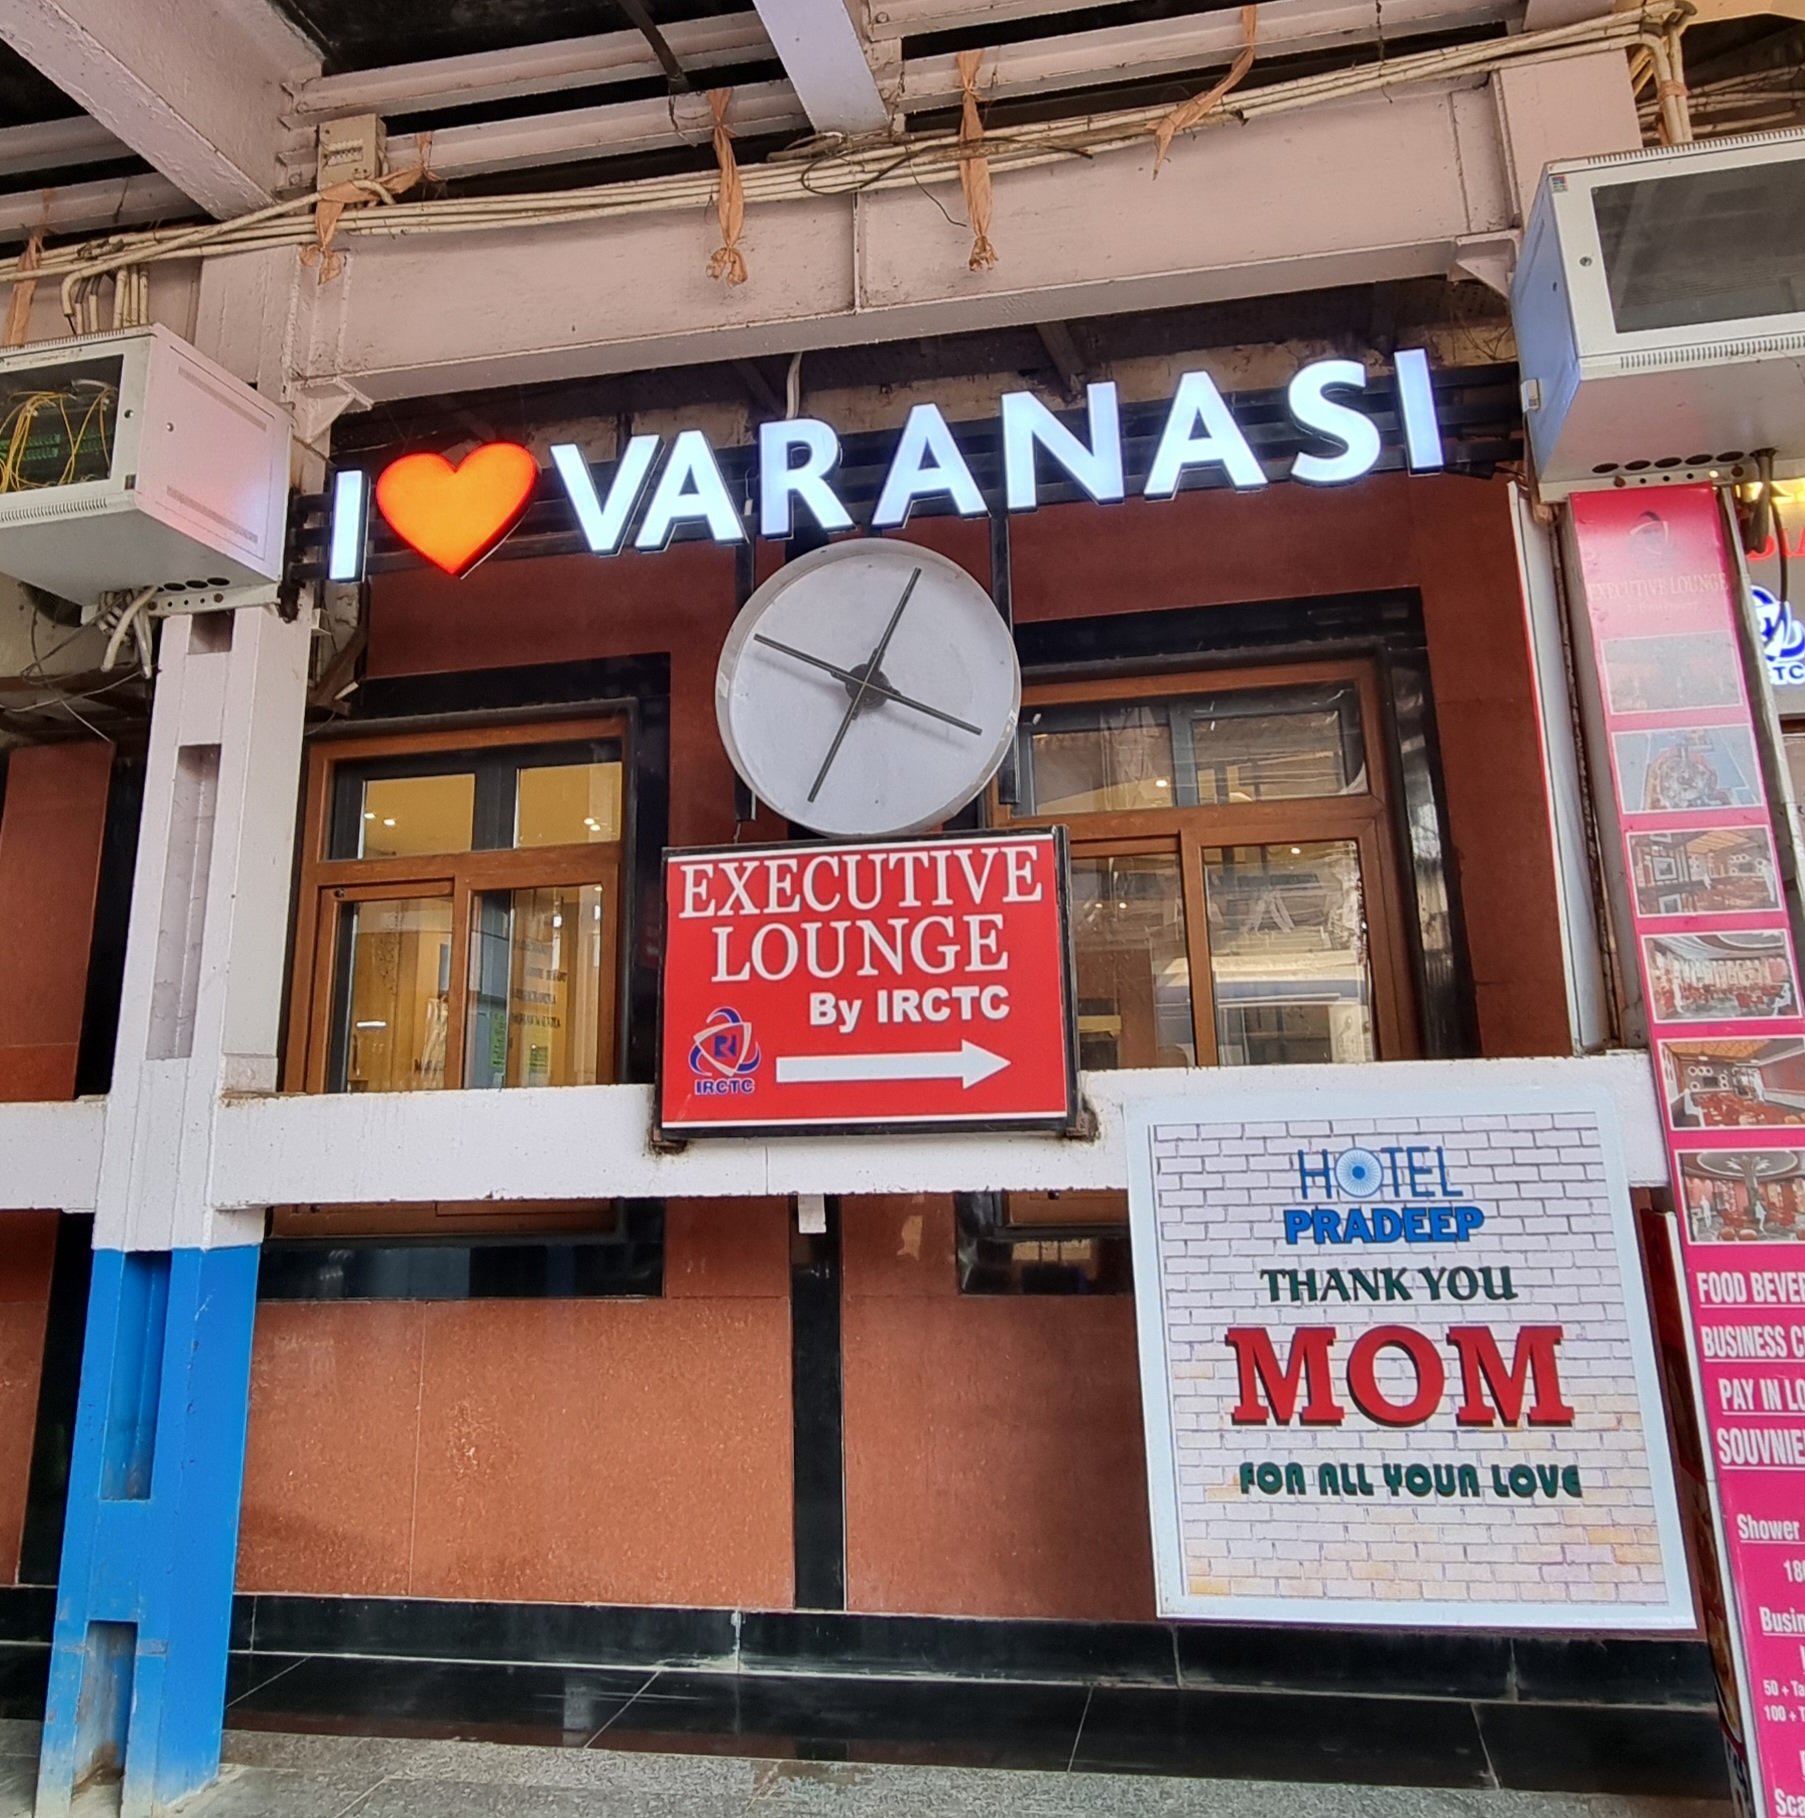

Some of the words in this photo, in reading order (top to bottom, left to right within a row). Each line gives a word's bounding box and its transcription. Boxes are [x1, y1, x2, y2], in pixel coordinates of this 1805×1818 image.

[328, 469, 364, 581] I
[550, 347, 1445, 555] VARANASI
[679, 845, 1042, 919] EXECUTIVE
[711, 914, 1009, 983] LOUNGE
[809, 992, 862, 1033] By
[877, 985, 1010, 1024] IRCTC
[694, 1079, 756, 1096] IRCTC
[1297, 1146, 1462, 1200] HOTEL
[1283, 1206, 1485, 1245] PRADEEP
[1260, 1268, 1411, 1303] THANK
[1420, 1265, 1519, 1302] YOU
[1696, 1272, 1747, 1303] FOOD
[1701, 1326, 1787, 1358] BUSINESS
[1224, 1324, 1575, 1427] MOM
[1719, 1379, 1755, 1410] PAY
[1760, 1379, 1782, 1410] IN
[1717, 1428, 1805, 1465] SOUVNIE
[1239, 1461, 1307, 1495] FOR
[1319, 1462, 1374, 1496] ALL
[1384, 1462, 1482, 1498] YOUR
[1492, 1463, 1583, 1499] LOVE
[1736, 1513, 1800, 1541] Shower
[1783, 1558, 1805, 1583] 18
[1763, 1680, 1778, 1697] 50
[1764, 1705, 1786, 1722] 100
